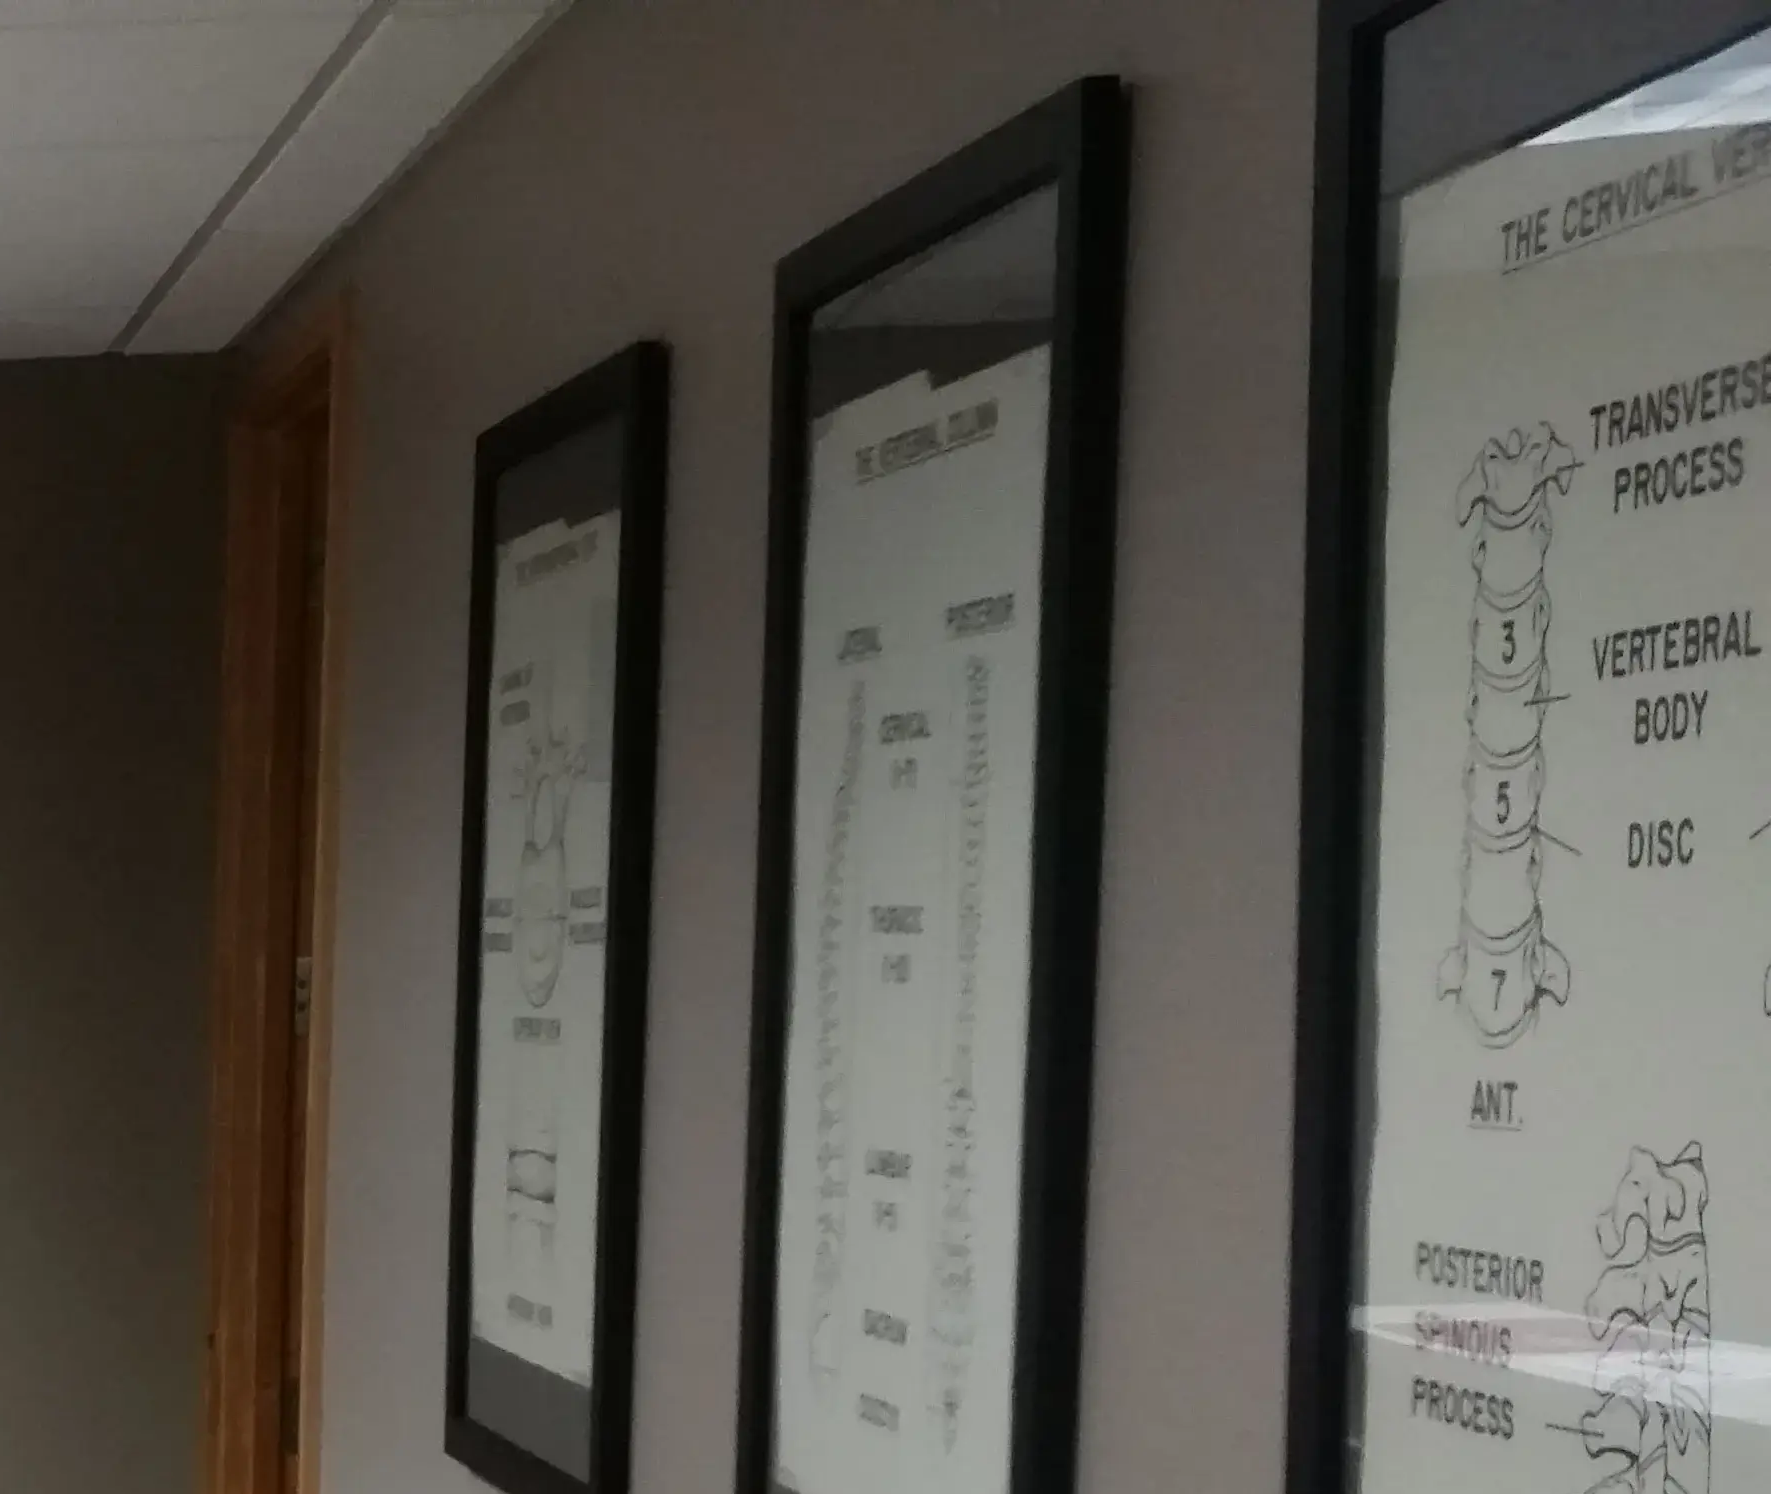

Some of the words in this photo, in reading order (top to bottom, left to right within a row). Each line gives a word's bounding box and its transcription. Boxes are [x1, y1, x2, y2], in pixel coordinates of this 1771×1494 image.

[1500, 207, 1551, 262] THE
[1562, 153, 1699, 244] CERVICAL
[1589, 351, 1771, 452] TRANSVERSE
[1613, 436, 1745, 514] PROCESS
[1501, 619, 1516, 664] 3
[1592, 610, 1762, 681] VERTEBRAL
[1634, 689, 1709, 745] BODY
[1496, 781, 1510, 824] 5
[1627, 817, 1694, 869] DISC
[1491, 968, 1507, 1011] 7
[1470, 1079, 1524, 1125] ANT.
[1416, 1241, 1544, 1303] POSTERIOR
[1415, 1310, 1512, 1369] SPINOUS
[1411, 1375, 1514, 1440] PROCESS
